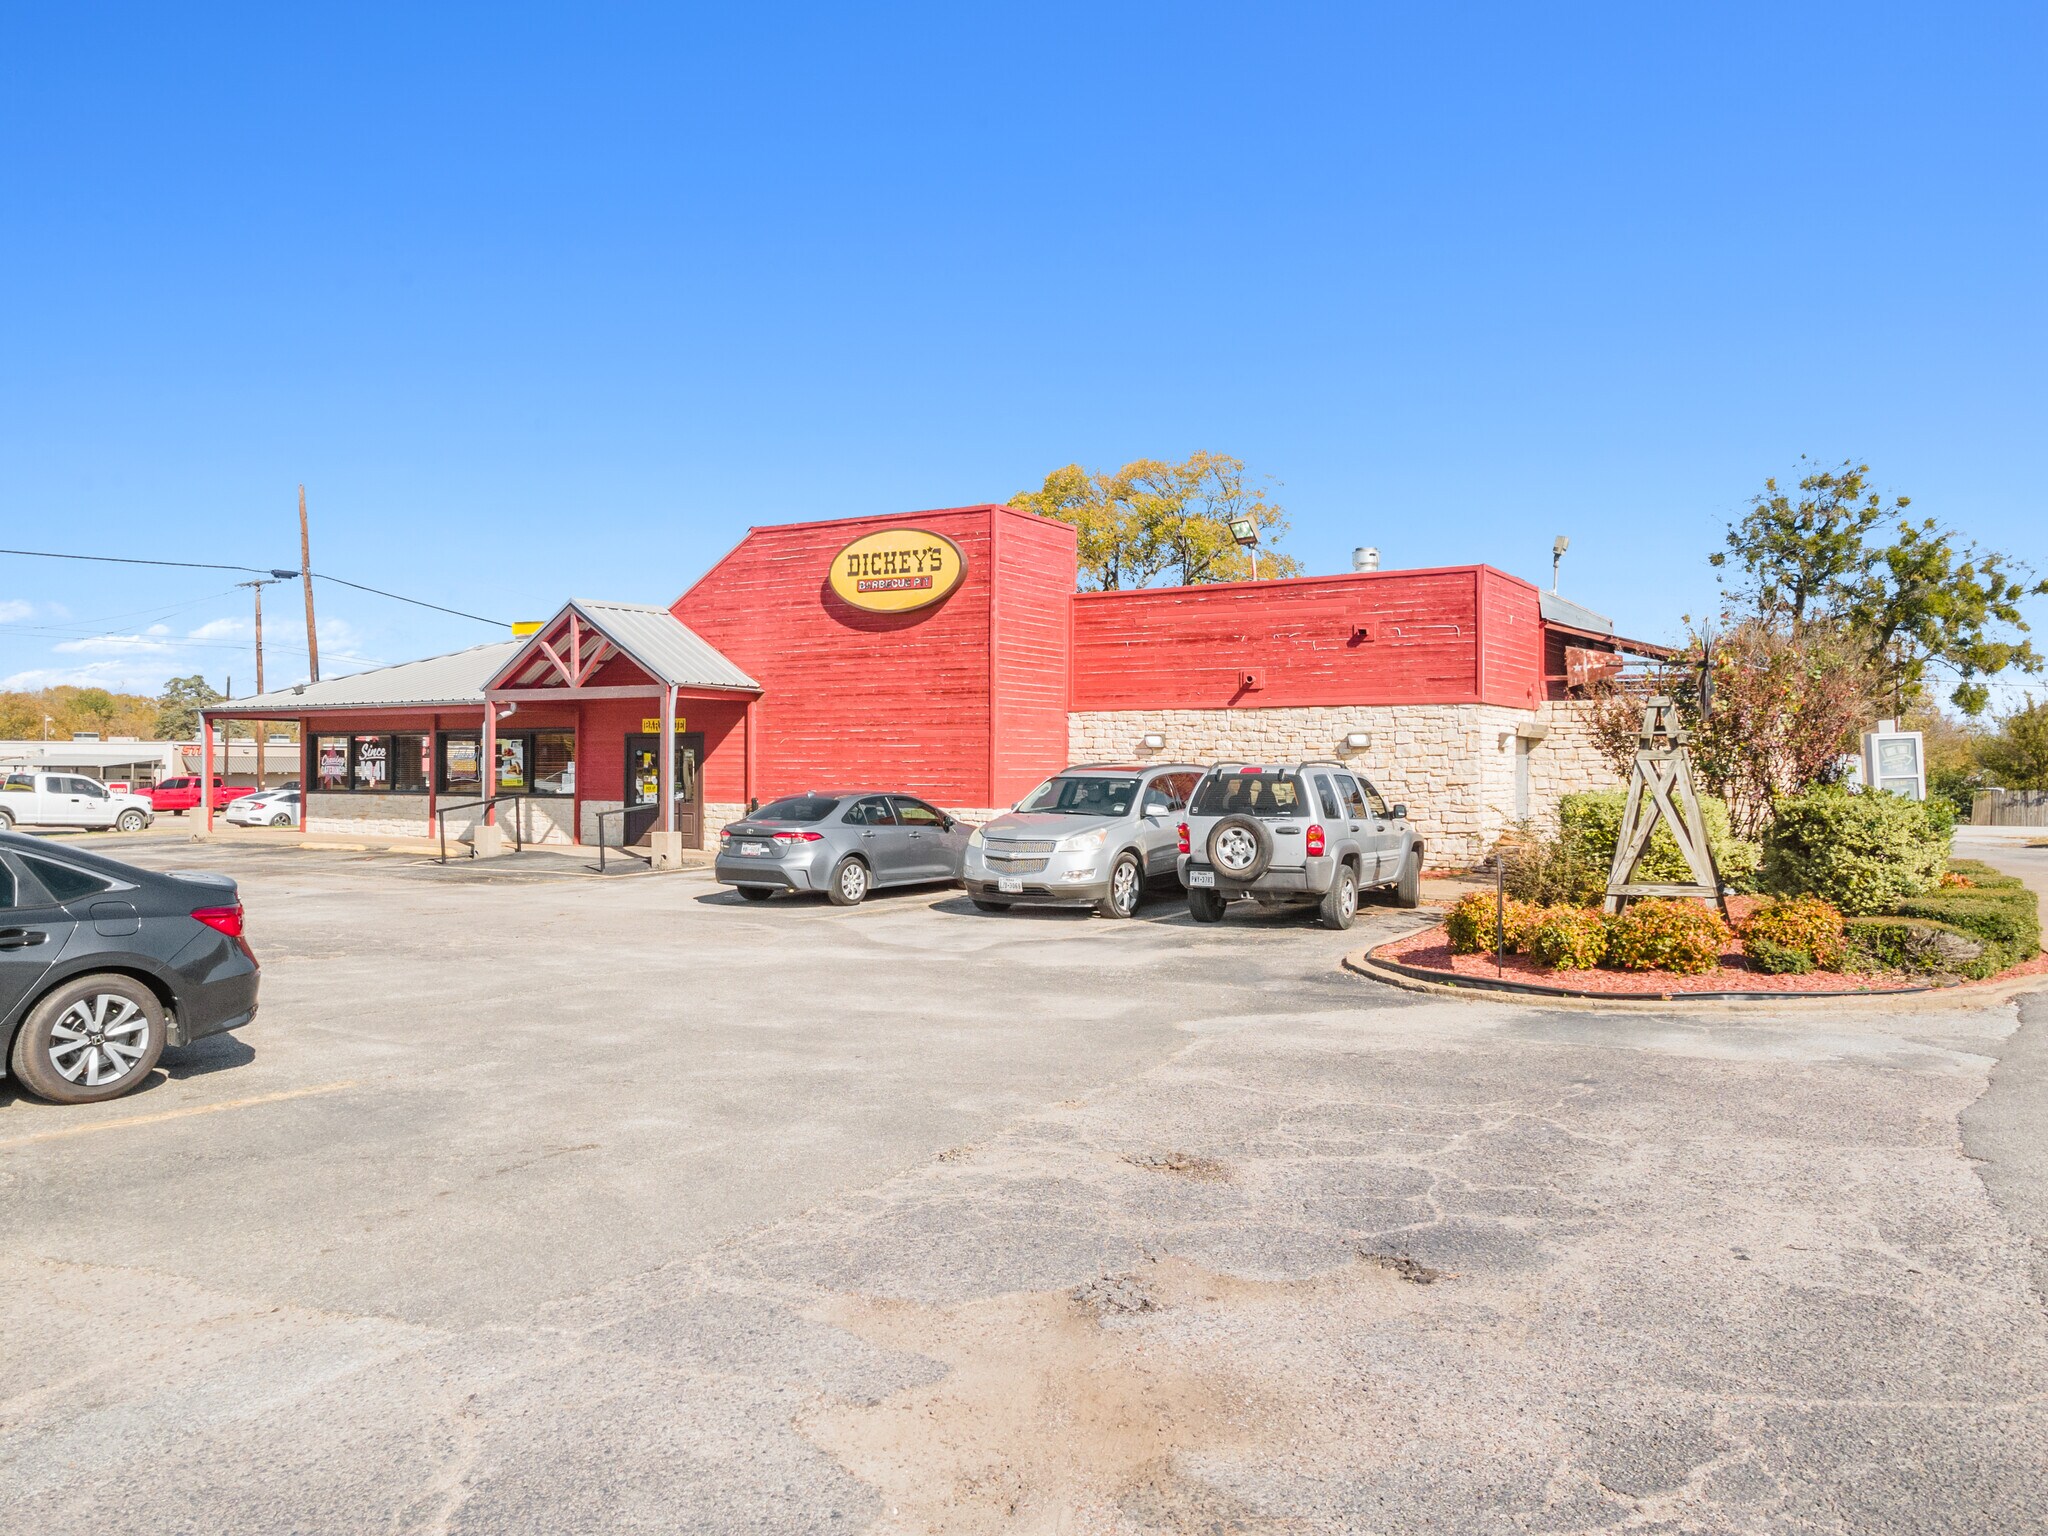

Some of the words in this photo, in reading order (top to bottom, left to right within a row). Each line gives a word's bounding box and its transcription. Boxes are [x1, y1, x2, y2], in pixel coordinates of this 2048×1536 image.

[847, 547, 943, 576] DICKEY'S
[859, 579, 911, 590] BARBECUE
[913, 577, 929, 587] PIT
[359, 743, 386, 760] Since
[360, 760, 386, 781] 1941
